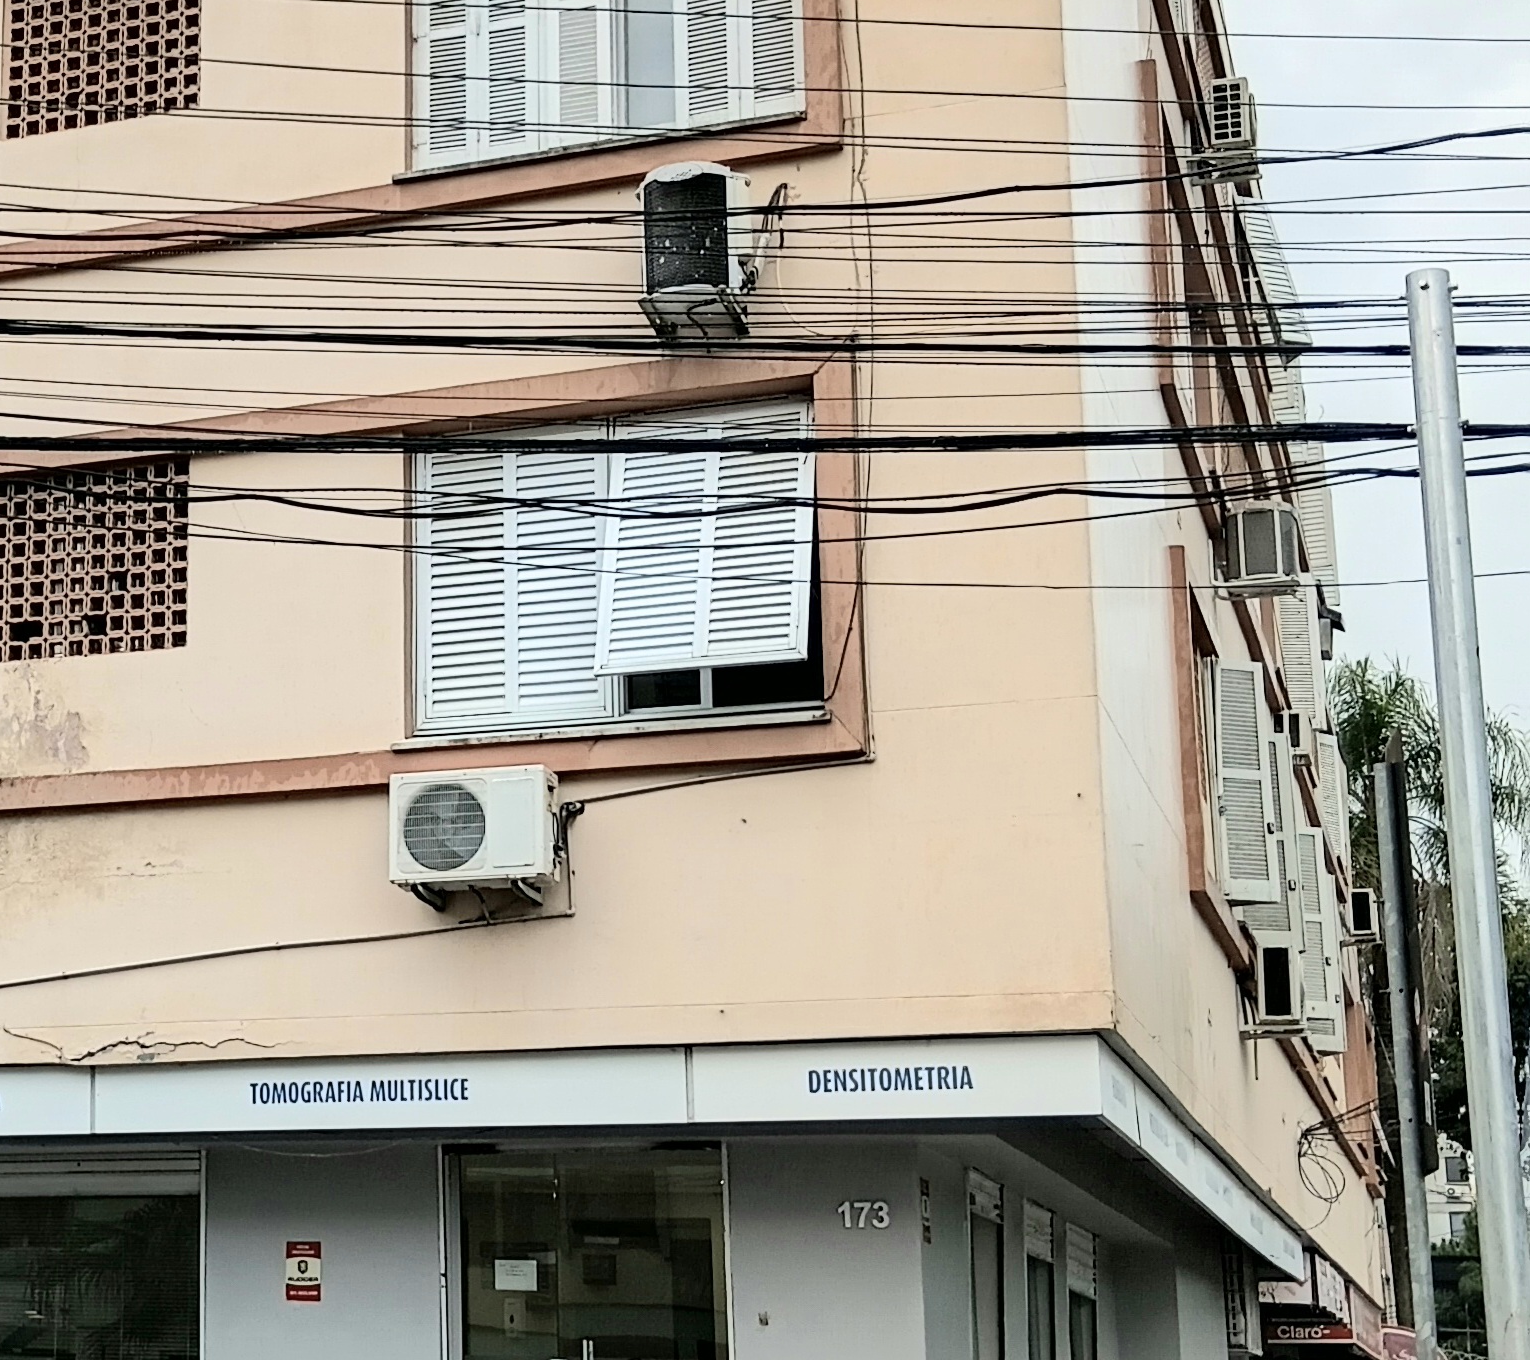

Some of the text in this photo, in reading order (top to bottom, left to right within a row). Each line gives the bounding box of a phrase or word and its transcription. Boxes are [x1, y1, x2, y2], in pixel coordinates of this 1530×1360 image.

[249, 1078, 469, 1105] TOMOGRAFIA MULTISLICE
[808, 1065, 974, 1093] DENSITOMETRIA
[837, 1200, 890, 1229] 173
[1276, 1324, 1323, 1339] Claro
